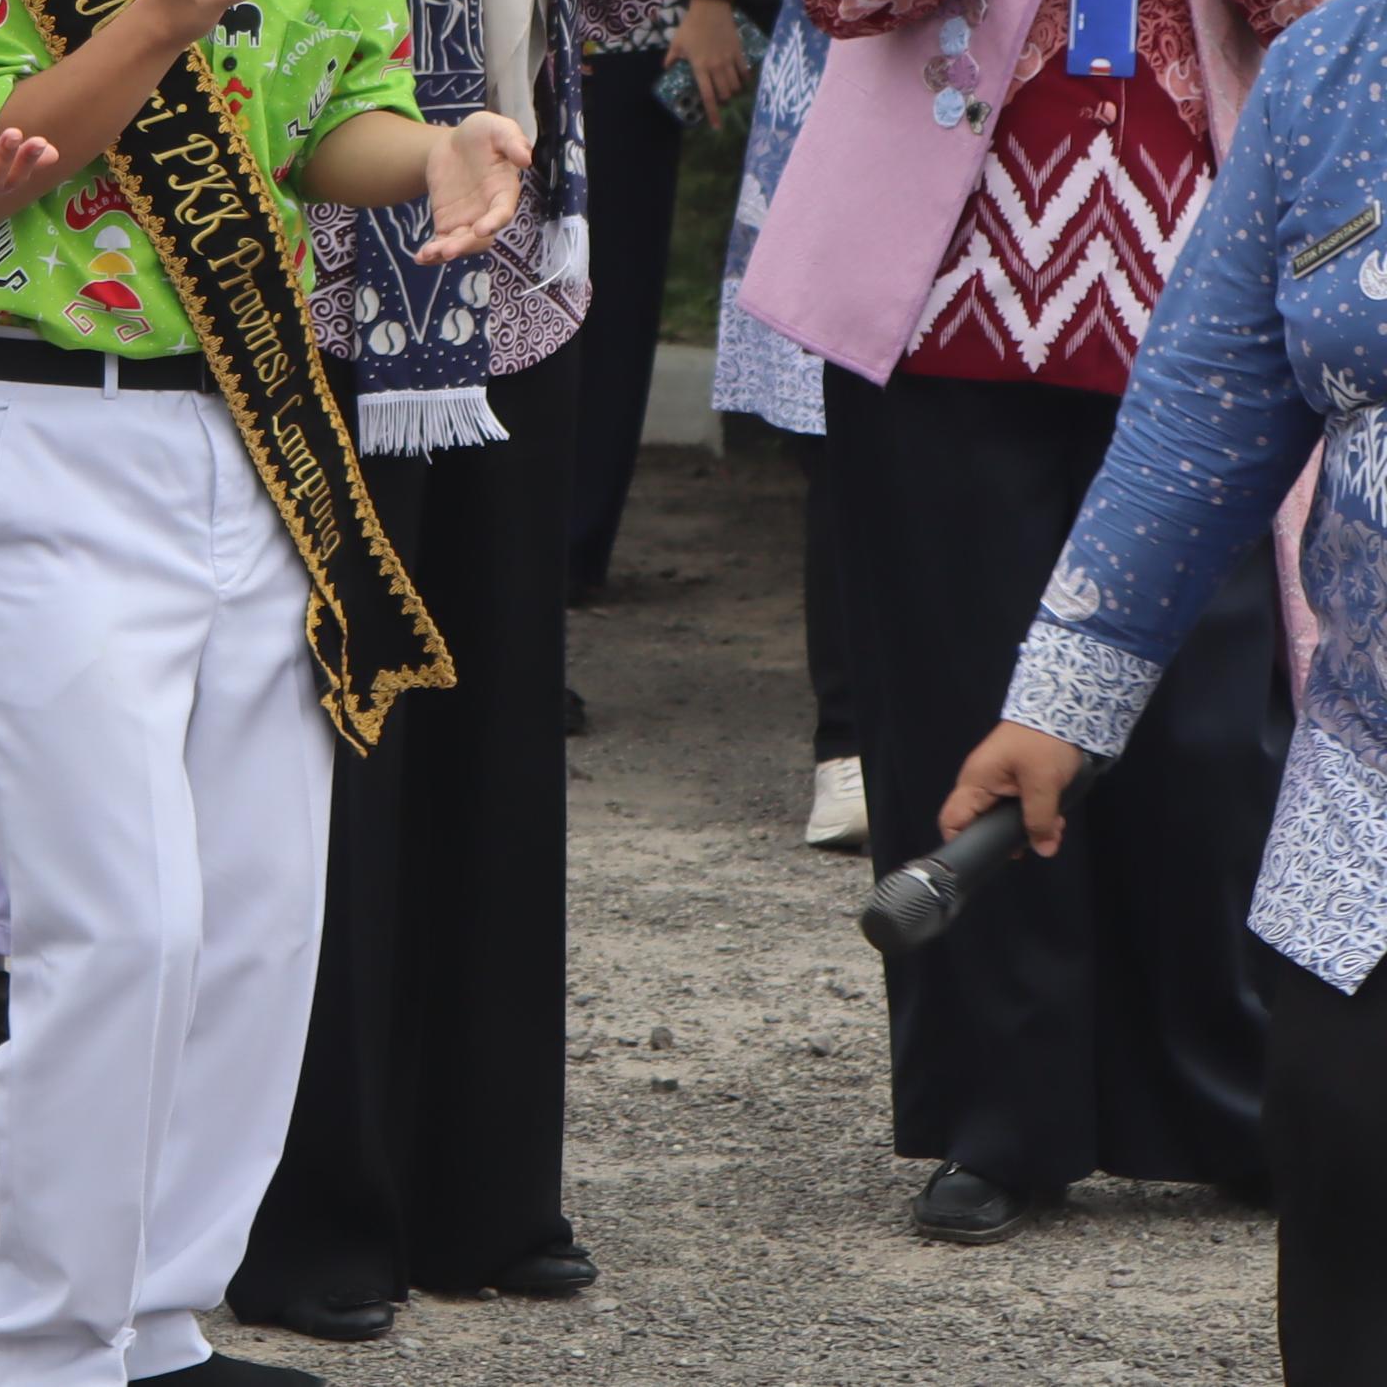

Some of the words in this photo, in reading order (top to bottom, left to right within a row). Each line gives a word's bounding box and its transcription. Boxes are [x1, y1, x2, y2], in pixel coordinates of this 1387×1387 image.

[88, 196, 110, 216] SLB
[150, 133, 251, 256] PKK
[207, 237, 296, 398] Provinsi
[272, 394, 341, 562] Lampung
